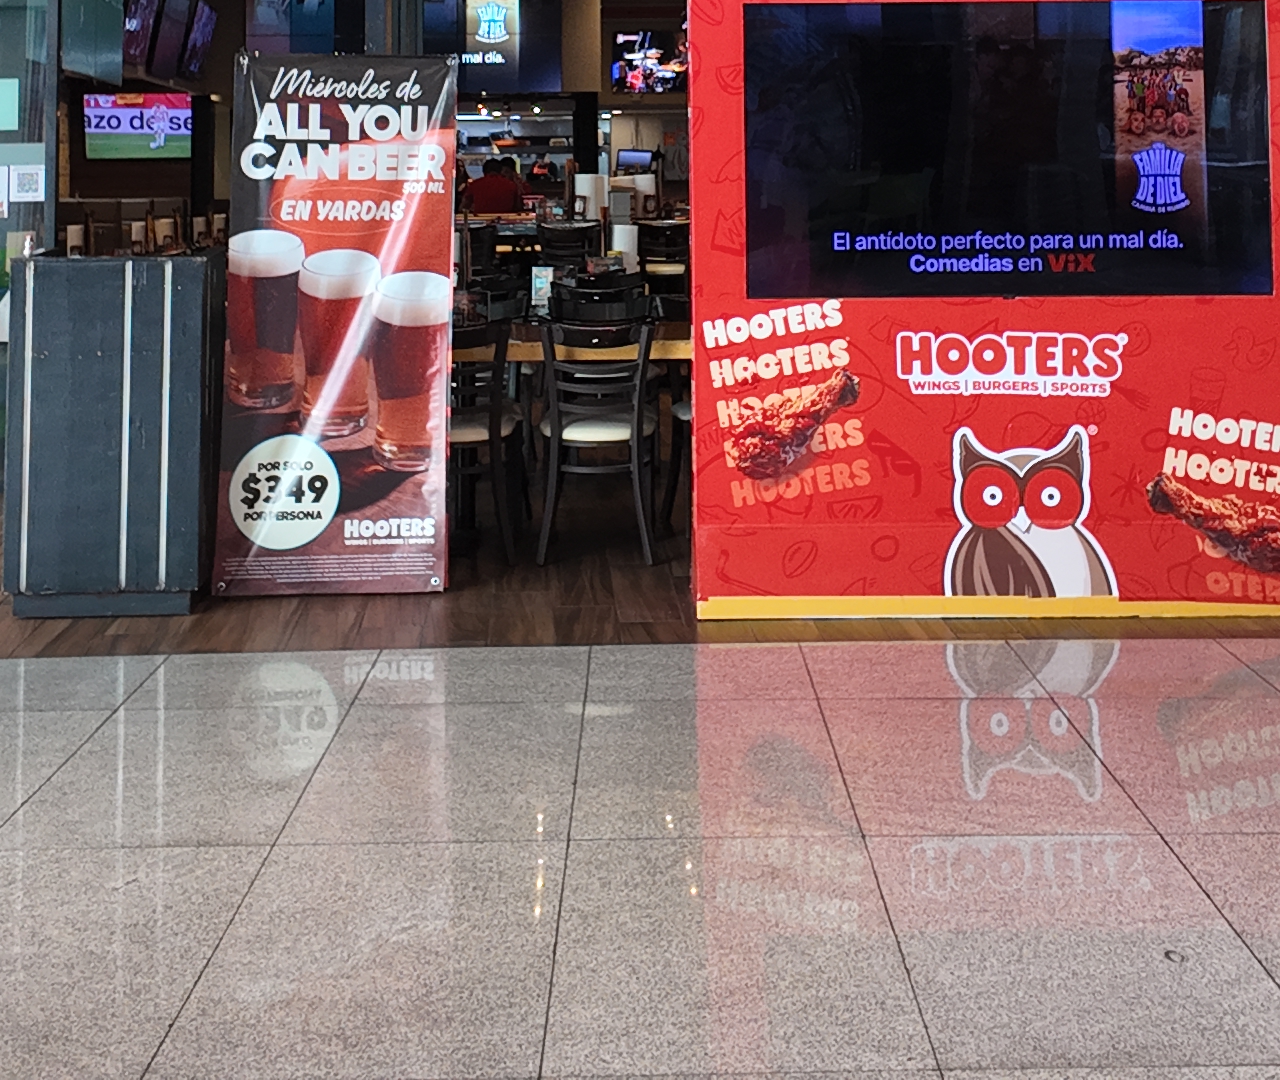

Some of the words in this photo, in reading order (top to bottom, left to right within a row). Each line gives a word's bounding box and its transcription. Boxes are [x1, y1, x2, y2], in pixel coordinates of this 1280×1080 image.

[461, 51, 484, 64] mal
[270, 67, 391, 100] Miércoles
[395, 70, 422, 102] de
[253, 103, 331, 140] ALL
[339, 104, 429, 142] YOU
[240, 142, 340, 180] CAN
[347, 144, 446, 181] BEER
[402, 182, 425, 194] 500
[427, 182, 446, 194] ML
[1135, 176, 1155, 203] DE
[280, 200, 313, 221] EN
[316, 200, 406, 222] YARDAS
[833, 232, 850, 251] El
[854, 231, 936, 250] antídoto
[941, 231, 1025, 253] perfecto
[1030, 235, 1072, 253] para
[1079, 235, 1104, 250] un
[1108, 231, 1144, 249] mal
[1148, 230, 1184, 250] día.
[909, 253, 1014, 273] Comedias
[1018, 257, 1043, 271] en
[1046, 253, 1097, 273] ViX
[702, 299, 844, 349] HOOTERS
[709, 338, 851, 389] HOOTERS
[898, 334, 1122, 380] HOOTERS
[912, 380, 961, 392] WINGS
[972, 380, 1039, 392] BURGERS
[1050, 381, 1108, 394] SPORTS
[257, 461, 281, 472] POR
[240, 473, 329, 509] $349
[730, 459, 871, 508] HOOTERS
[243, 511, 267, 521] POR
[269, 511, 323, 521] PERSONA
[344, 518, 436, 538] HOOTERS
